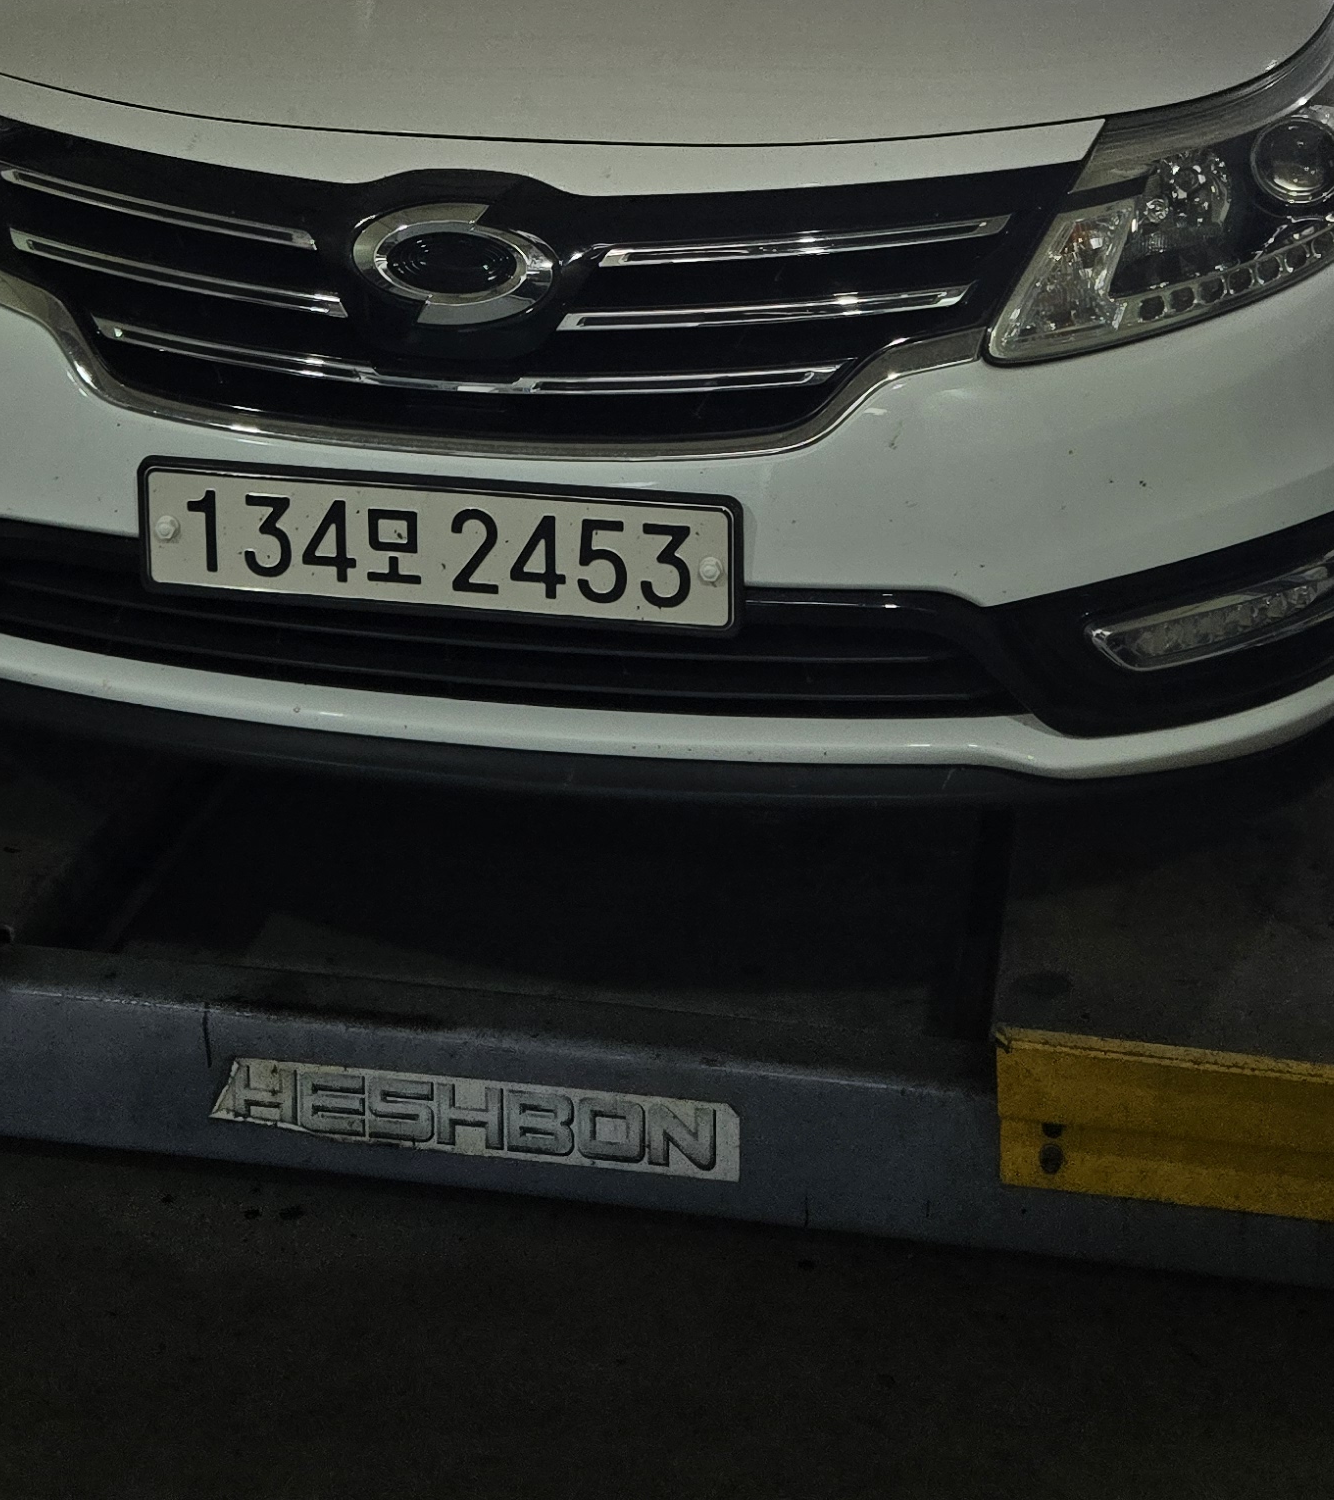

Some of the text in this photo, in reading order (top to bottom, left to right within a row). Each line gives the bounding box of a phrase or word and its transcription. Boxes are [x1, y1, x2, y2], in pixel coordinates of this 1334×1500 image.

[186, 488, 691, 608] 134모 2453
[217, 1062, 718, 1171] HESHBON
